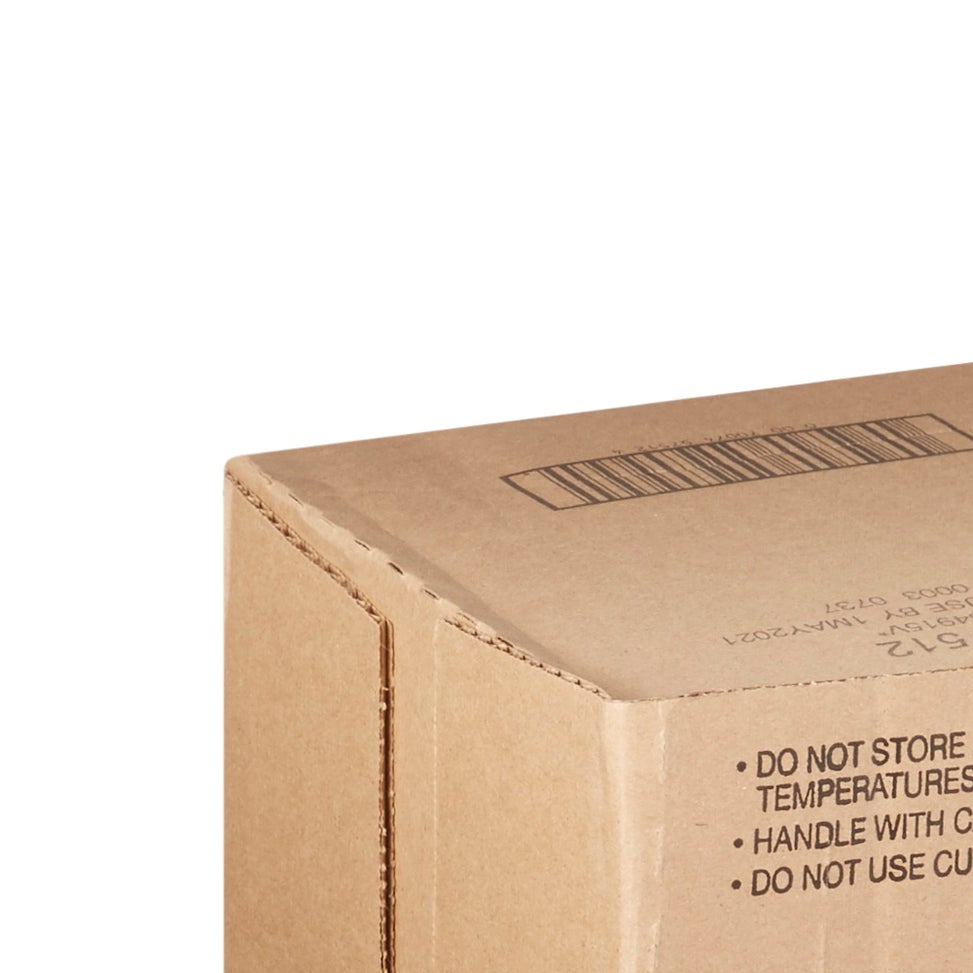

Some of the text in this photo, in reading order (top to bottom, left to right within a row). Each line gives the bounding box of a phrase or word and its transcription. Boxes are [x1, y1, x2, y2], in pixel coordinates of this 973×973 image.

[824, 583, 970, 614] 0003 0737
[884, 605, 922, 621] BY
[722, 615, 867, 646] 1MAY2021
[756, 747, 798, 778] DO
[807, 741, 865, 774] NOT
[871, 731, 966, 767] STORE
[753, 816, 867, 854] HANDLE
[874, 808, 945, 842] WITH
[751, 866, 794, 896] DO
[802, 858, 862, 890] NOT
[868, 853, 926, 884] USE
